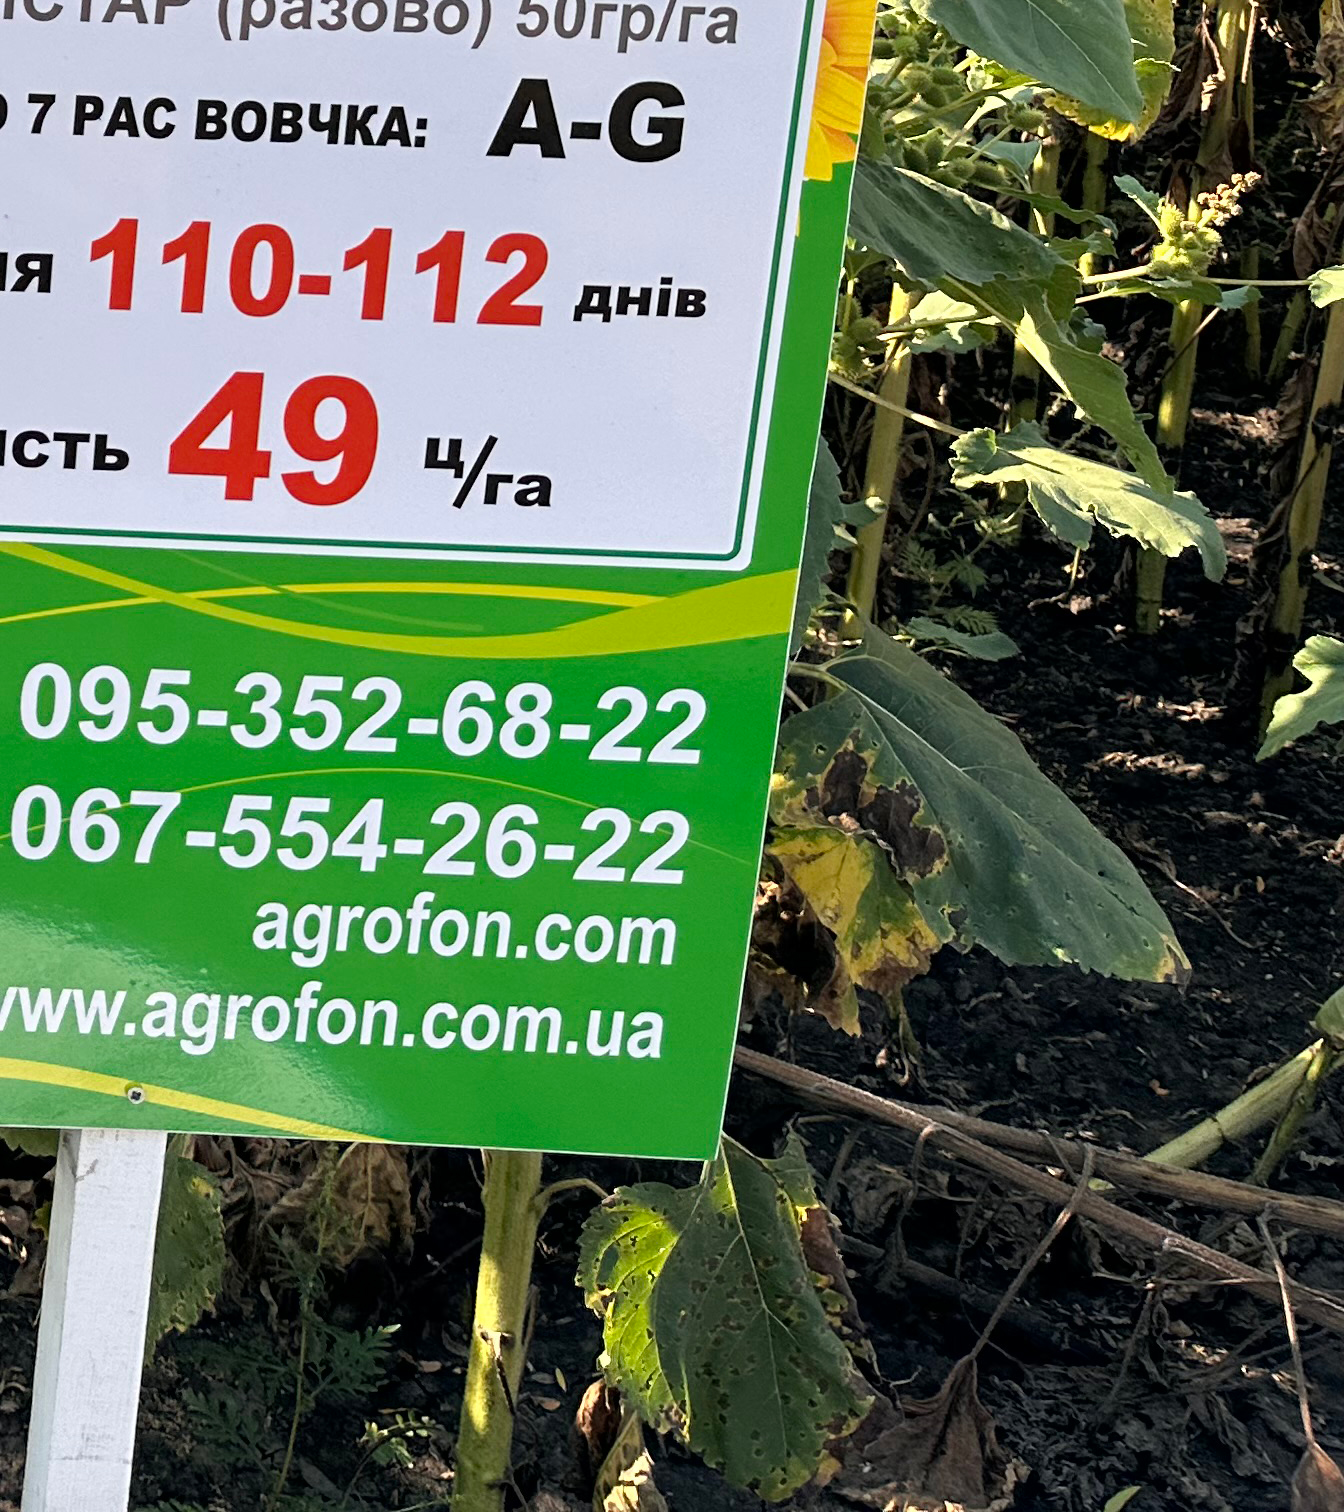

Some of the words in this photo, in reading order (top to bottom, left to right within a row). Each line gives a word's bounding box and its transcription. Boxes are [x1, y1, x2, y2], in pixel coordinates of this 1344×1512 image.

[28, 93, 56, 134] 7
[73, 95, 176, 139] РАС
[195, 100, 427, 147] ВОВЧКА:
[486, 78, 685, 162] A-G
[91, 218, 548, 326] 110-112
[573, 277, 706, 323] днів
[168, 372, 378, 506] 49
[424, 435, 551, 509] ц/га
[20, 664, 706, 764] 095-352-68-22
[12, 786, 688, 883] 067-554-26-22
[253, 892, 677, 968] agrofon.com
